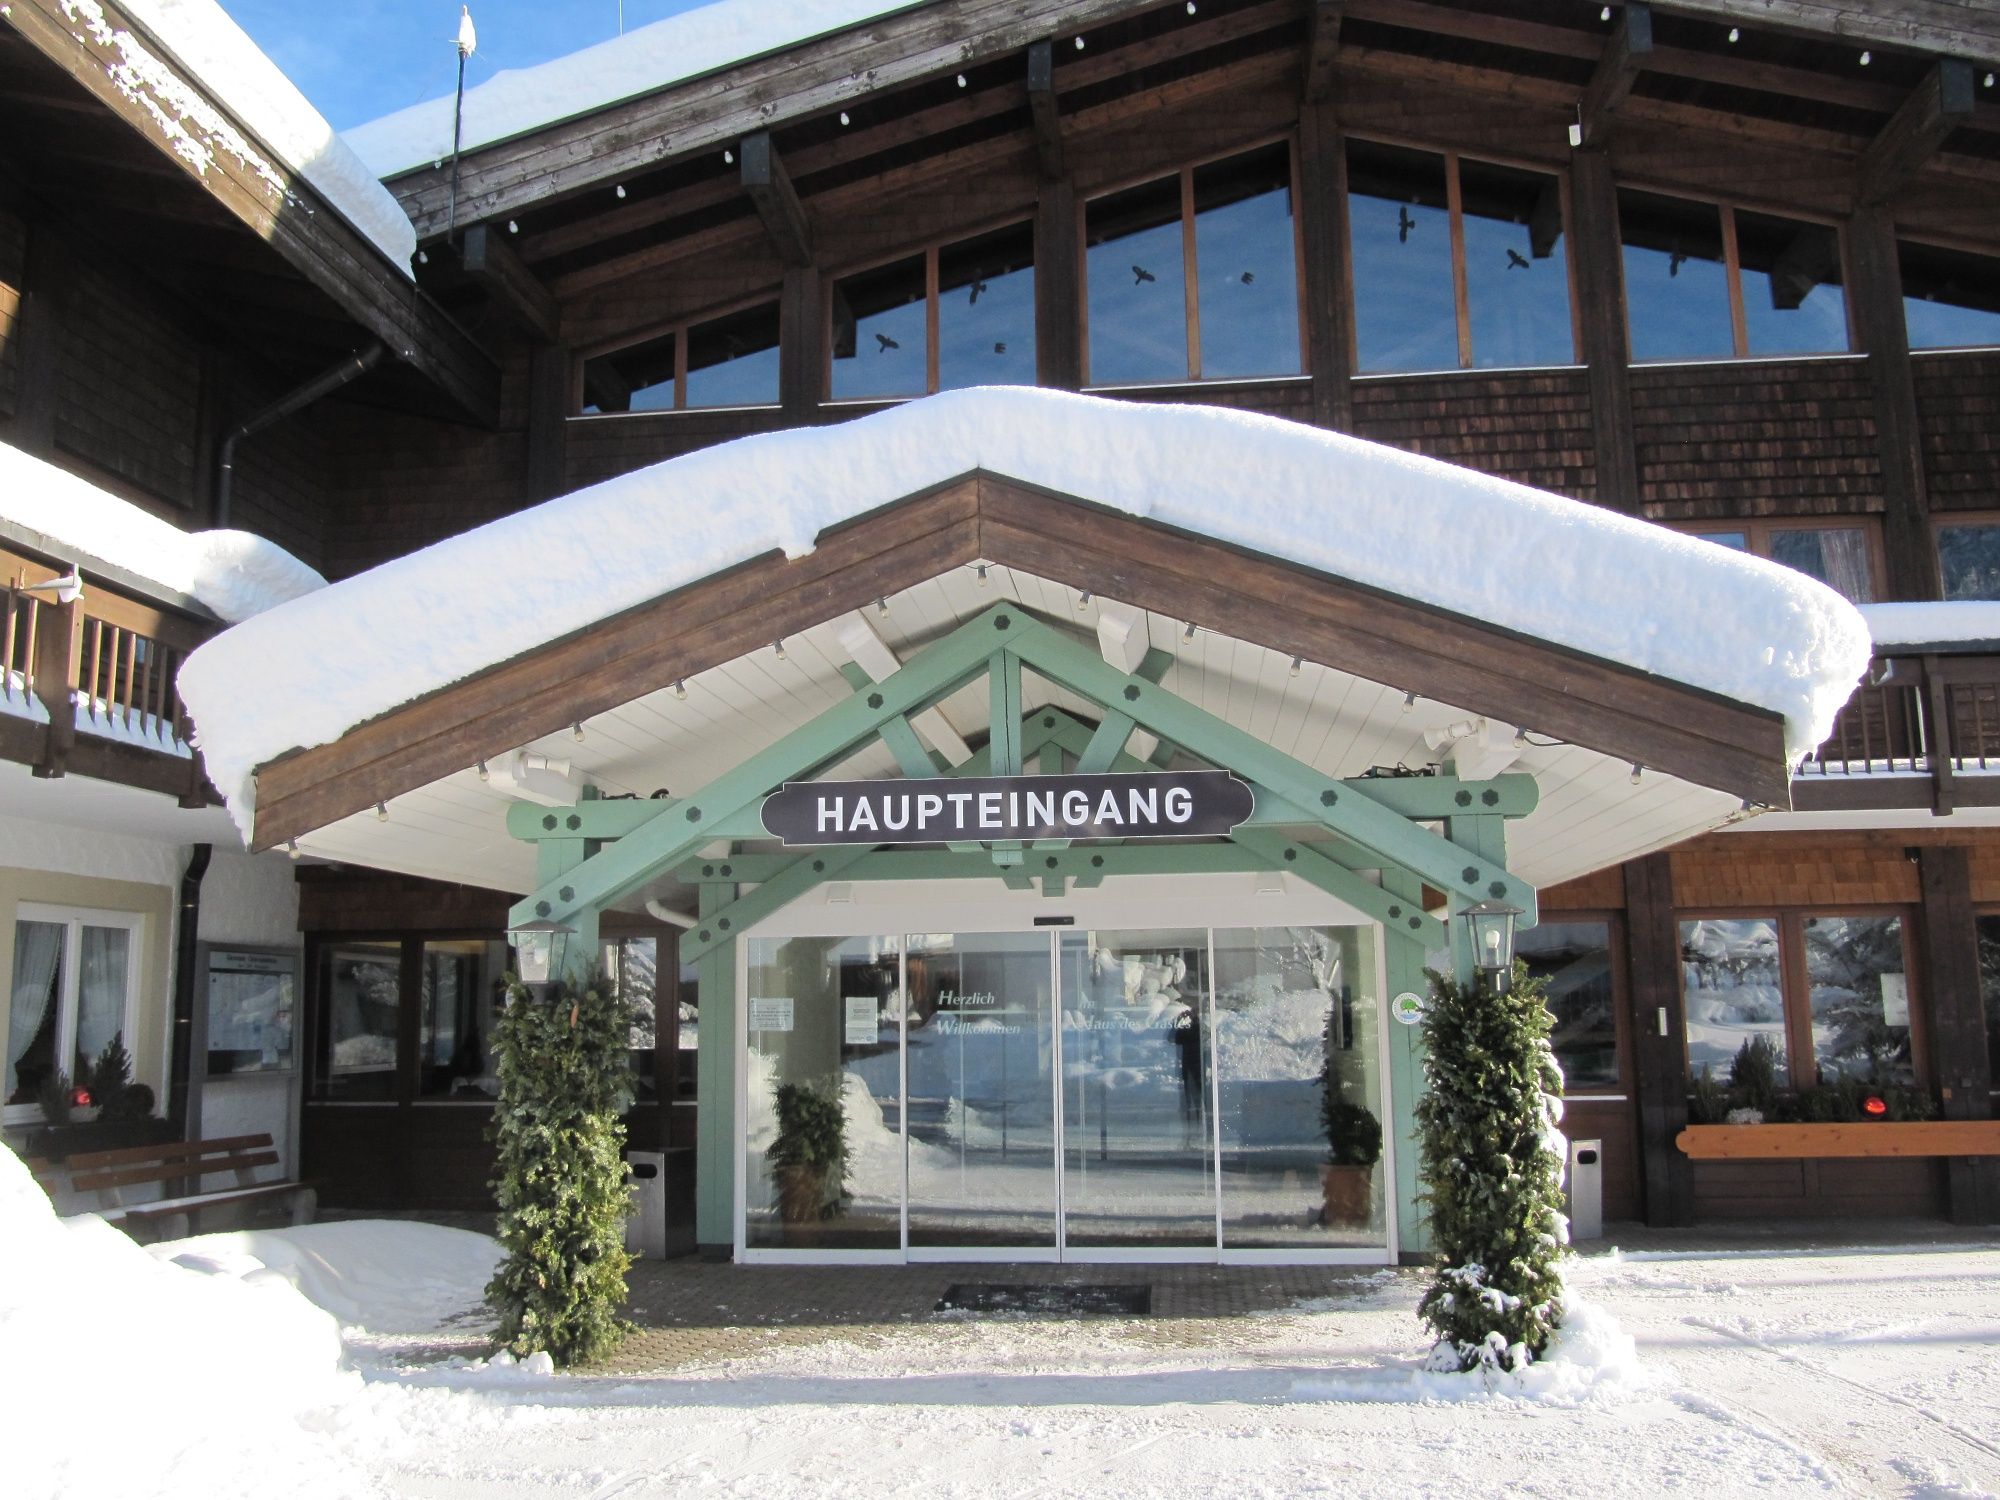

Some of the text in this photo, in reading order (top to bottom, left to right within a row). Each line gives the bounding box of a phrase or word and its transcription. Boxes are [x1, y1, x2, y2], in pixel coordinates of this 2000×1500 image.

[816, 786, 1194, 832] HAUPTEINGANG
[938, 989, 995, 1005] Herzlich
[937, 1019, 1021, 1035] Willkommen
